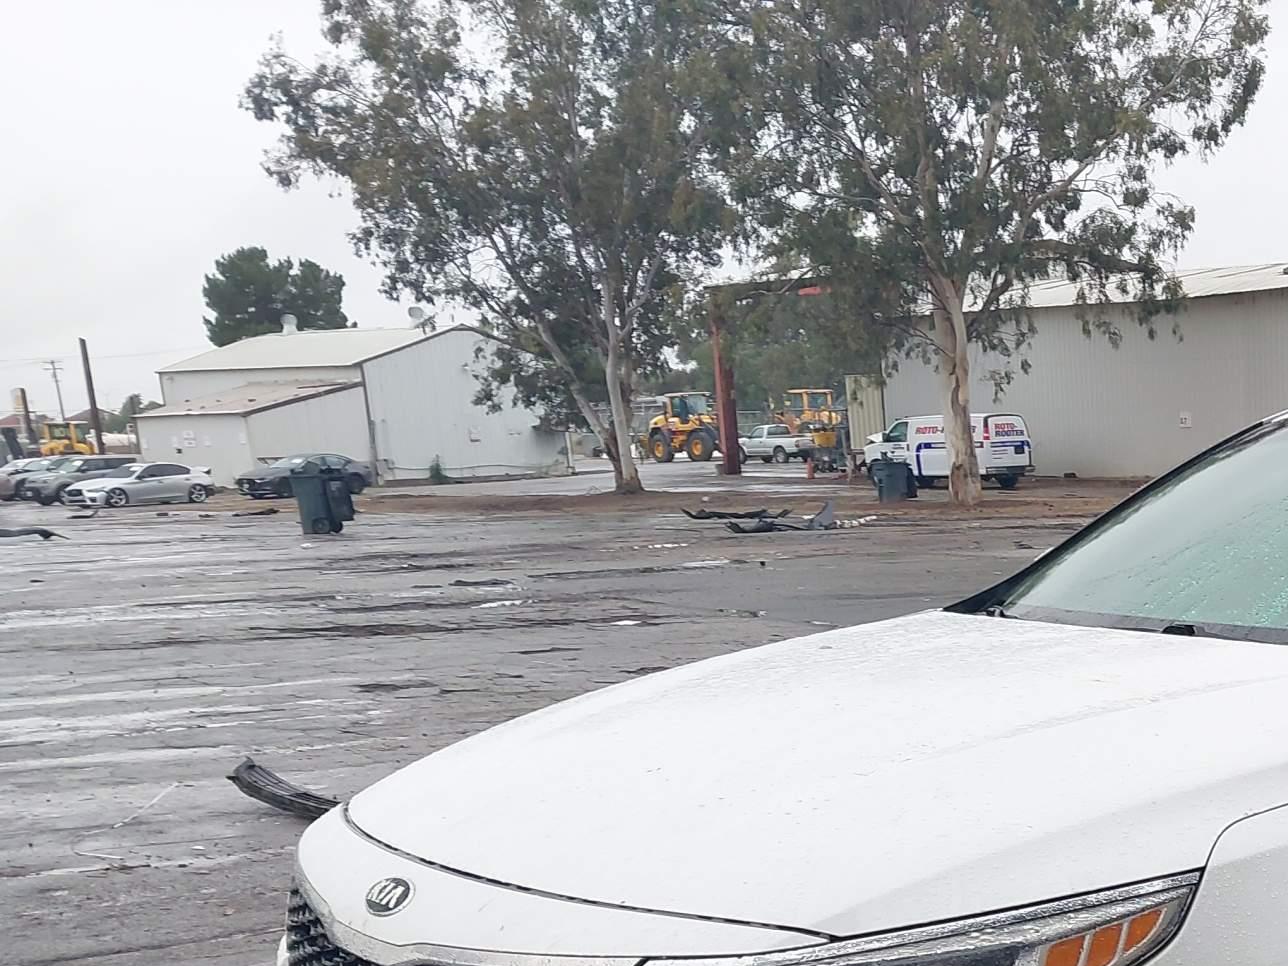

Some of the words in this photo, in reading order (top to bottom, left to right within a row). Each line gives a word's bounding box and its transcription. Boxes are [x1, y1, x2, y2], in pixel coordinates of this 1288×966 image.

[993, 422, 1018, 430] ROTO-
[994, 429, 1025, 437] ROOTER
[367, 878, 406, 909] KIA
